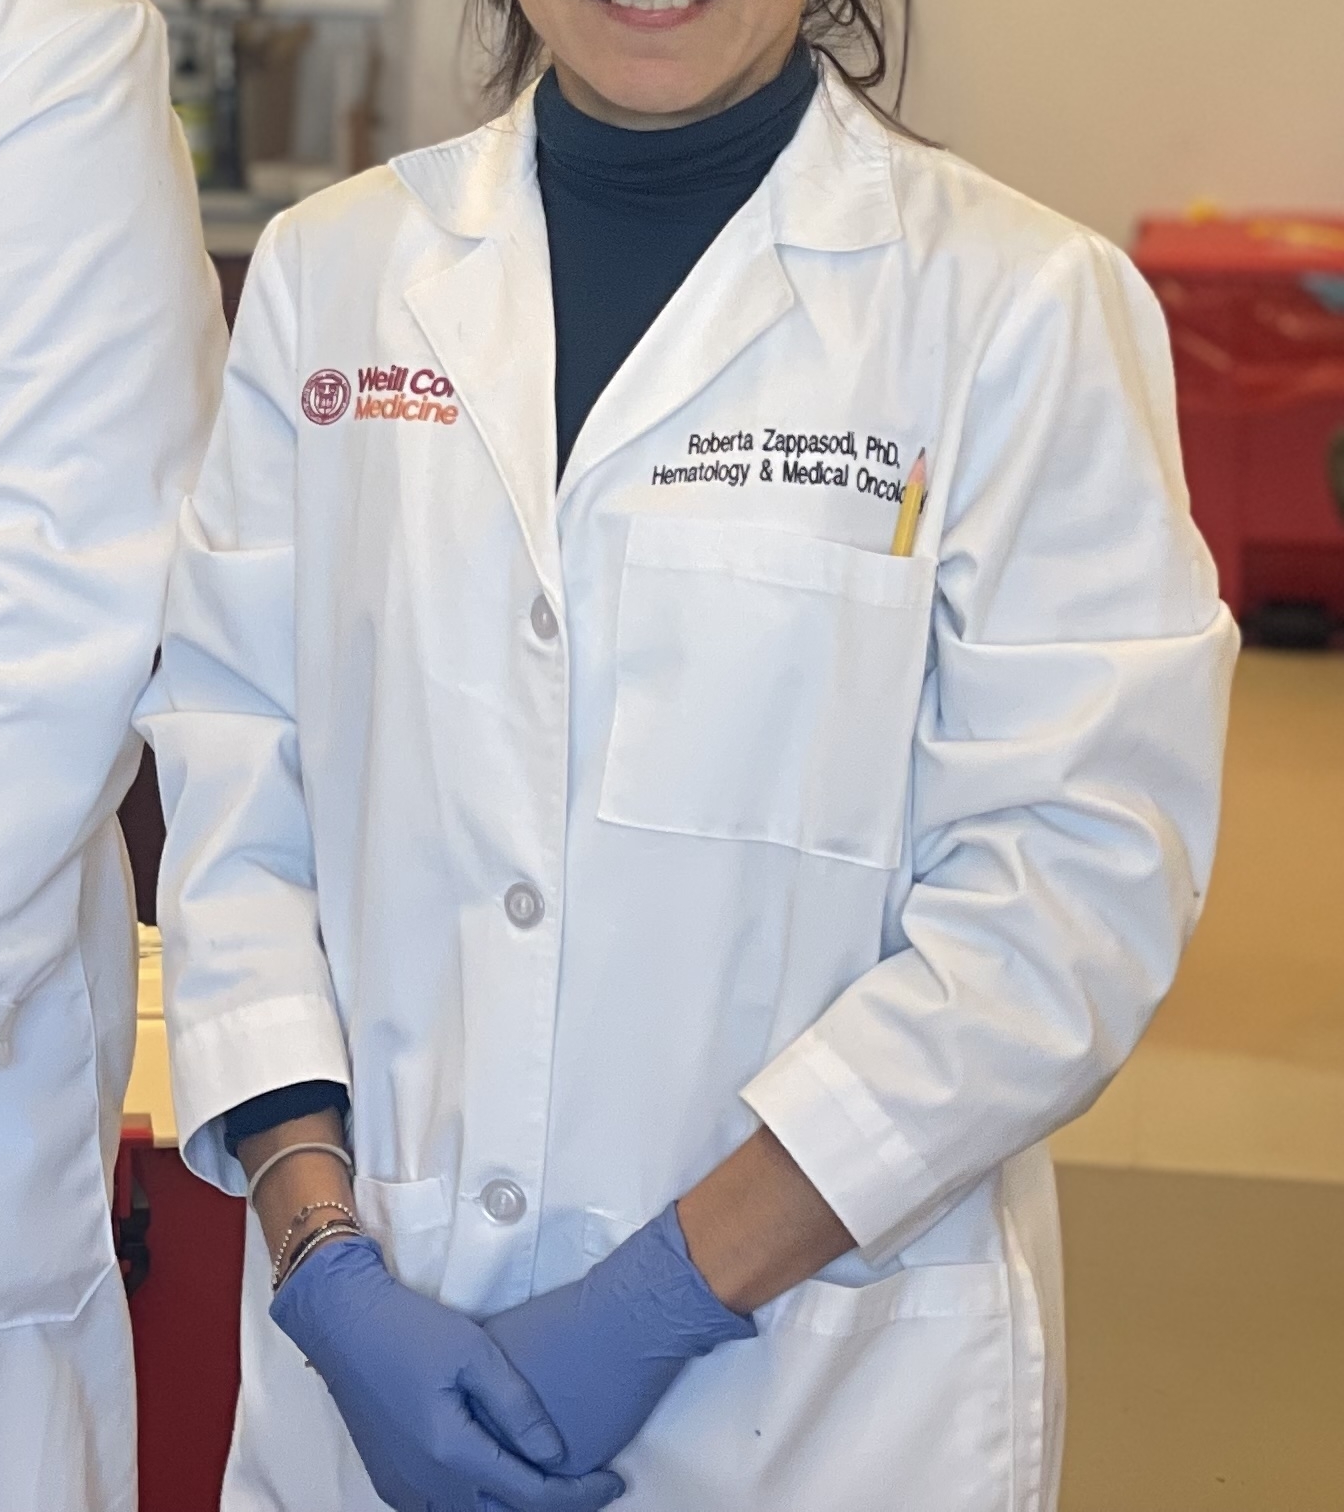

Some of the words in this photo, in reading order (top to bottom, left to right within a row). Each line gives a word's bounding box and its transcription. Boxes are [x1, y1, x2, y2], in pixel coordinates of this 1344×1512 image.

[357, 364, 409, 394] Weill
[354, 393, 460, 426] Medicine
[687, 430, 754, 456] Roberta
[762, 428, 858, 461] Zappasodi,
[651, 459, 751, 488] Hematology
[759, 458, 773, 483] &
[782, 460, 849, 488] Medical
